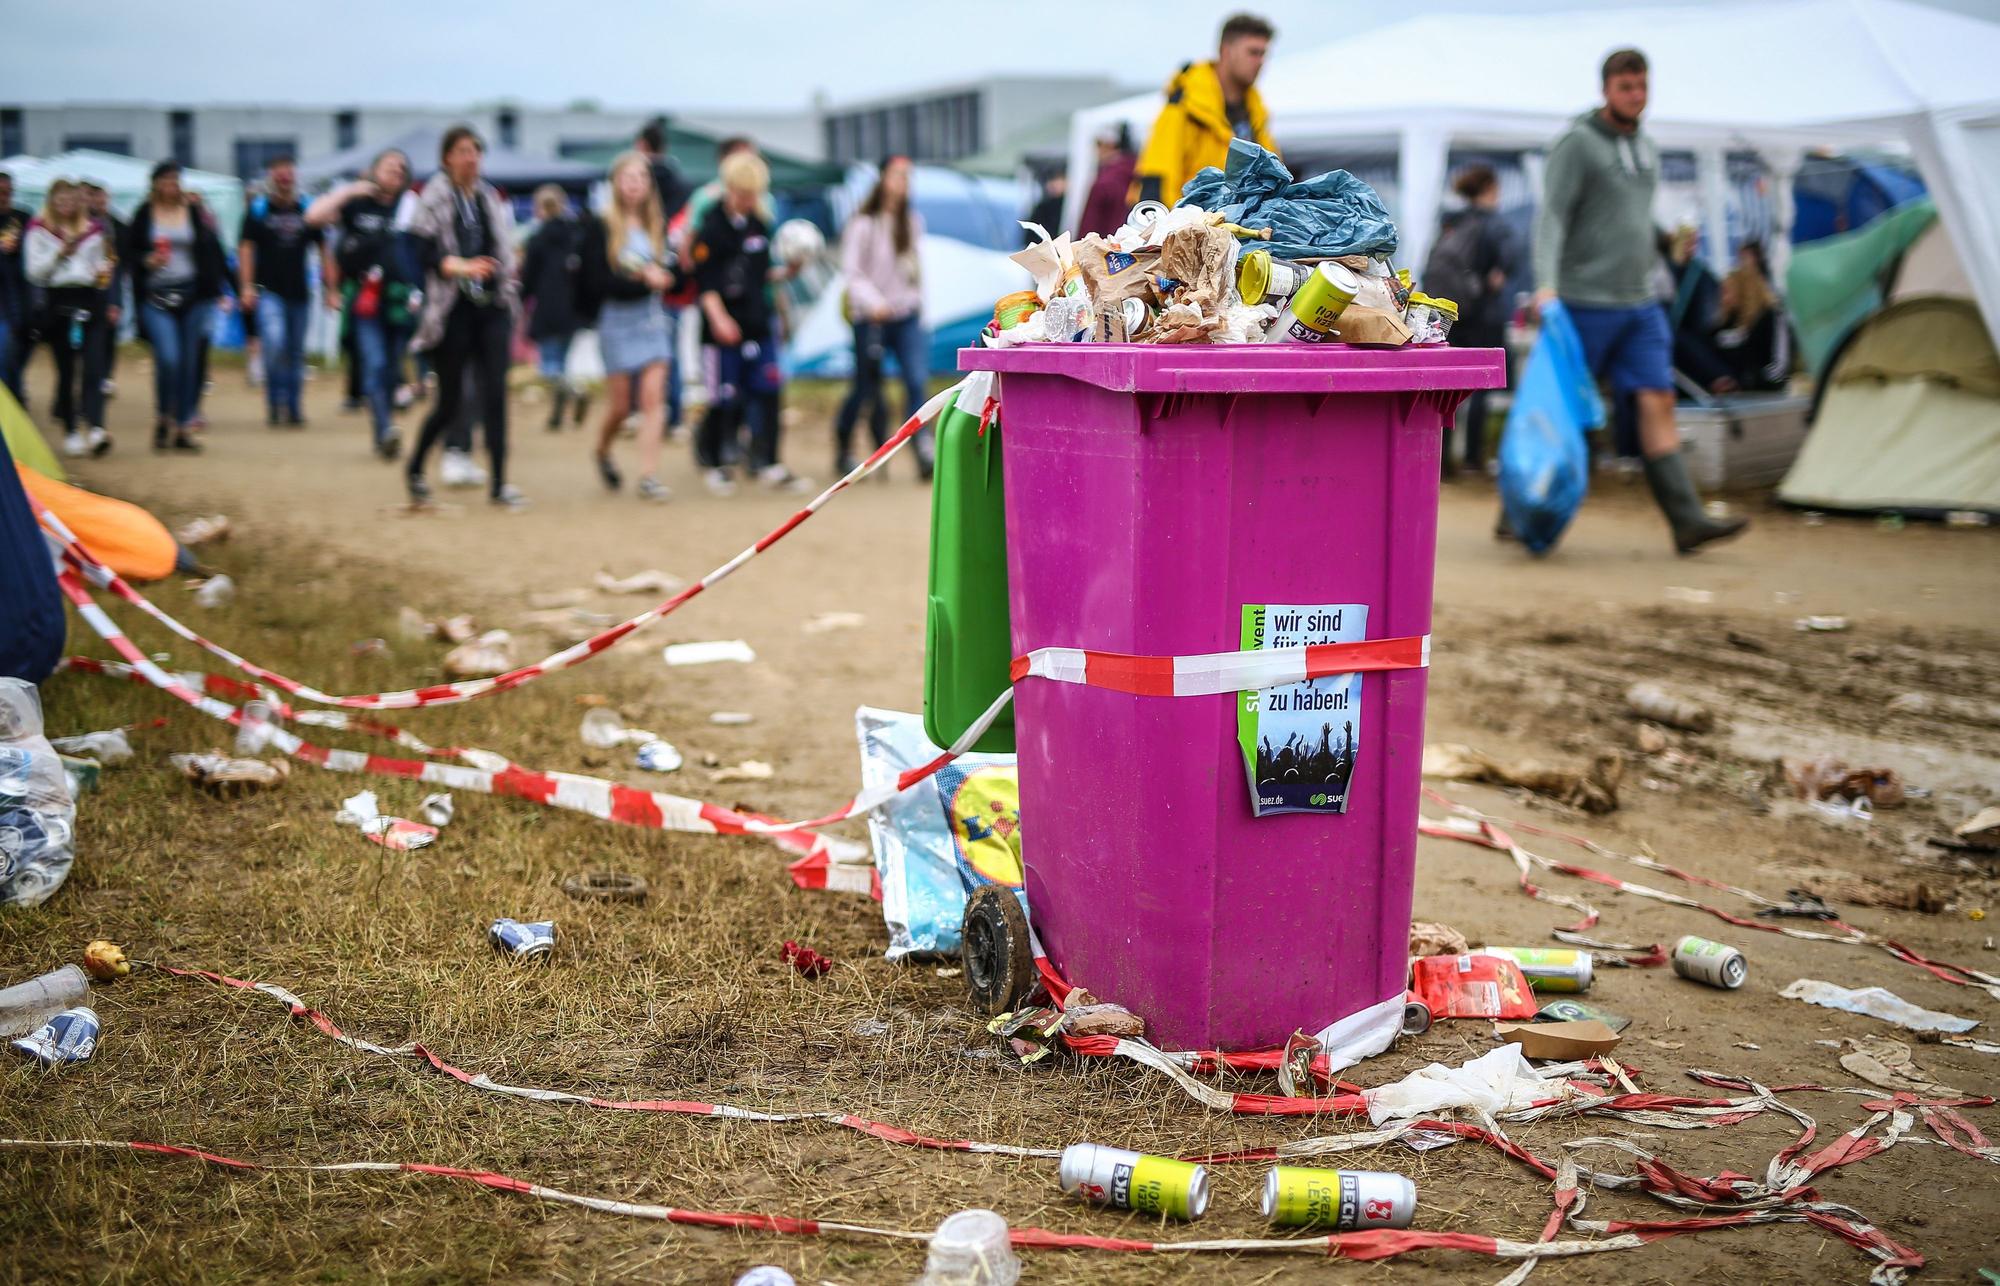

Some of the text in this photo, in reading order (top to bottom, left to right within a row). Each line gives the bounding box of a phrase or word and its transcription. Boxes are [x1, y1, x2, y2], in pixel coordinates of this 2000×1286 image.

[1109, 254, 1123, 272] ALDI
[1274, 609, 1342, 632] wir sind
[1269, 688, 1349, 711] zu haben!
[1327, 794, 1344, 803] sue
[1342, 1176, 1356, 1226] BECK
